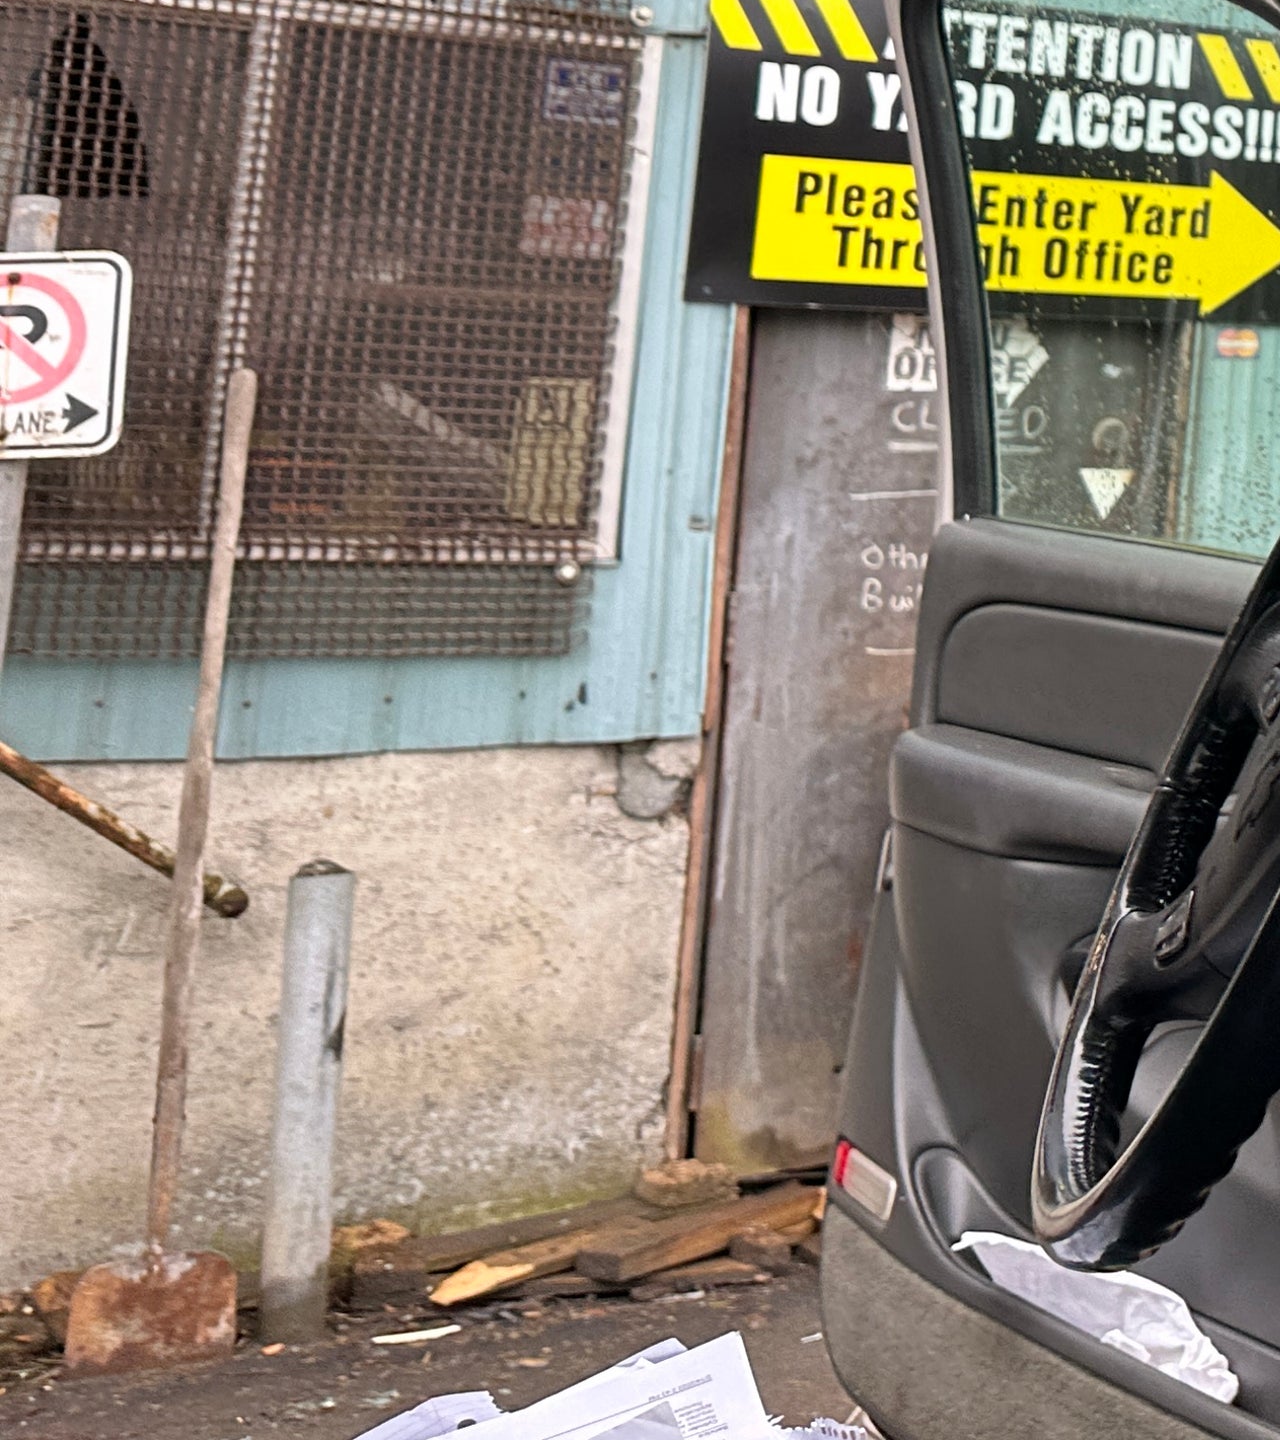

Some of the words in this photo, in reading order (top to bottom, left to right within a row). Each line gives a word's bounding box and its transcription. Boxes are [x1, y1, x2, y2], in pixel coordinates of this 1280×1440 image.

[756, 60, 841, 127] NO
[866, 70, 1015, 141] YRD
[795, 170, 920, 222] Pleas
[977, 183, 1098, 232] Enter
[1119, 192, 1212, 240] Yard
[1042, 237, 1175, 285] Office
